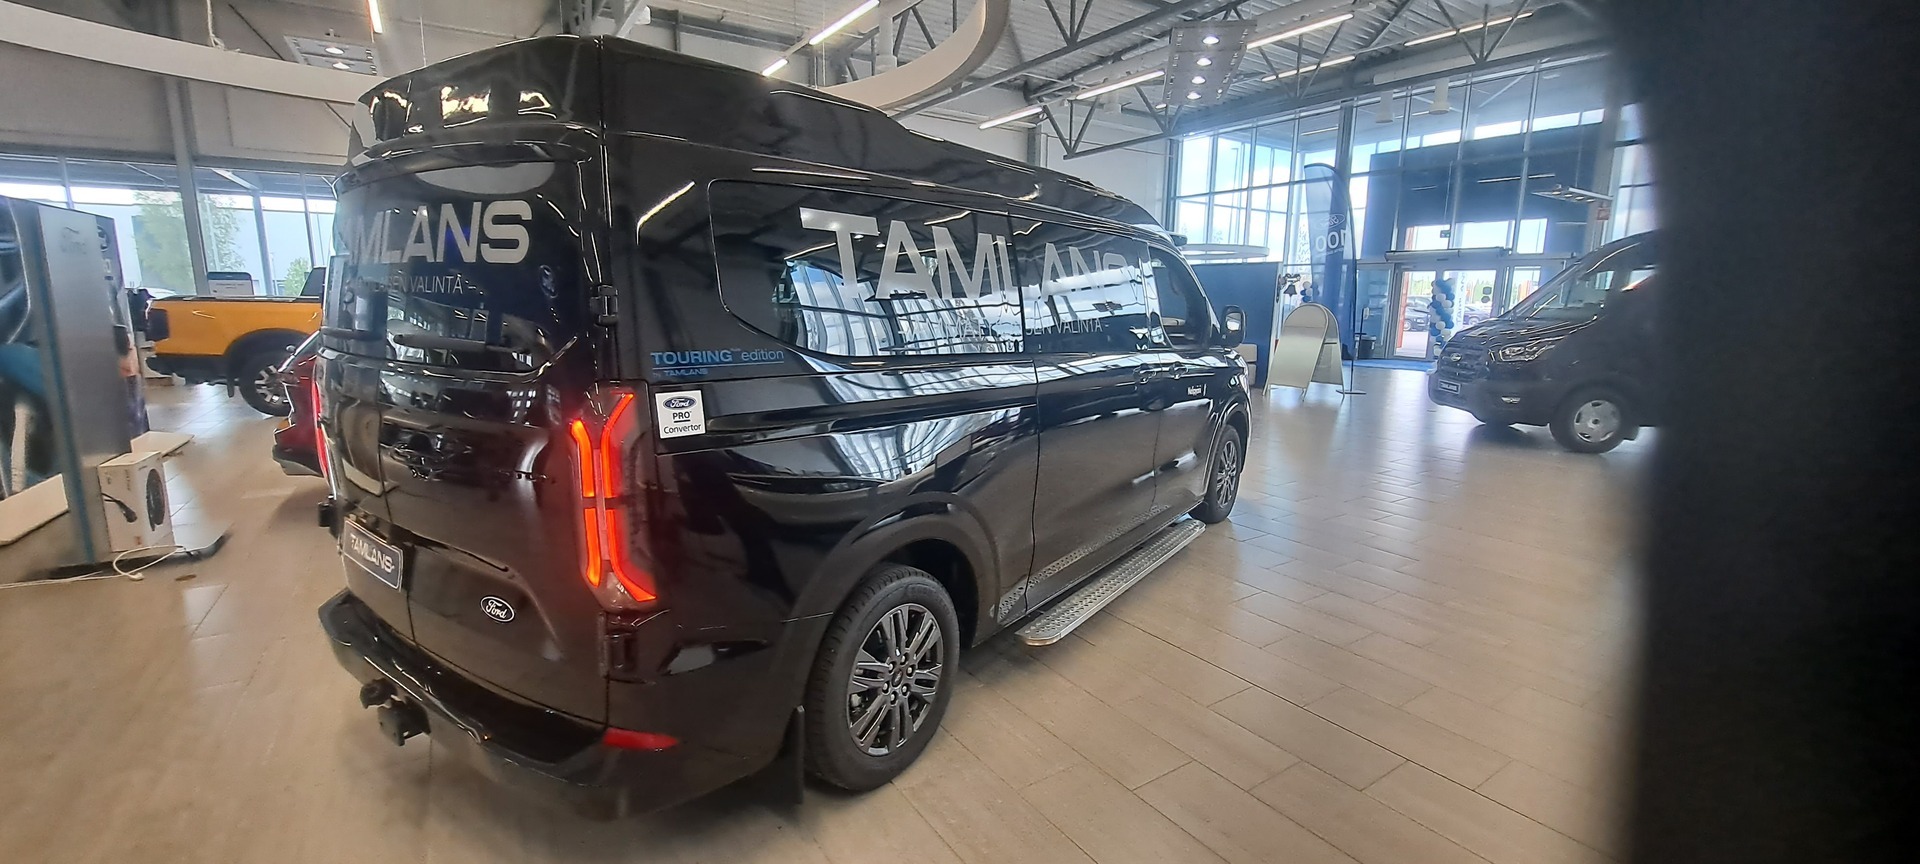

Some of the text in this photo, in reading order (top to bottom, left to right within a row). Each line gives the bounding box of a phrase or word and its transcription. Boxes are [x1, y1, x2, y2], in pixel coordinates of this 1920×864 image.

[650, 349, 784, 365] TOURING edition
[664, 368, 708, 376] TAMLANS
[670, 398, 690, 408] Ford
[672, 411, 690, 420] PRO
[663, 424, 702, 434] Convertor
[350, 533, 394, 573] TAMLANS
[485, 600, 508, 619] Ford
